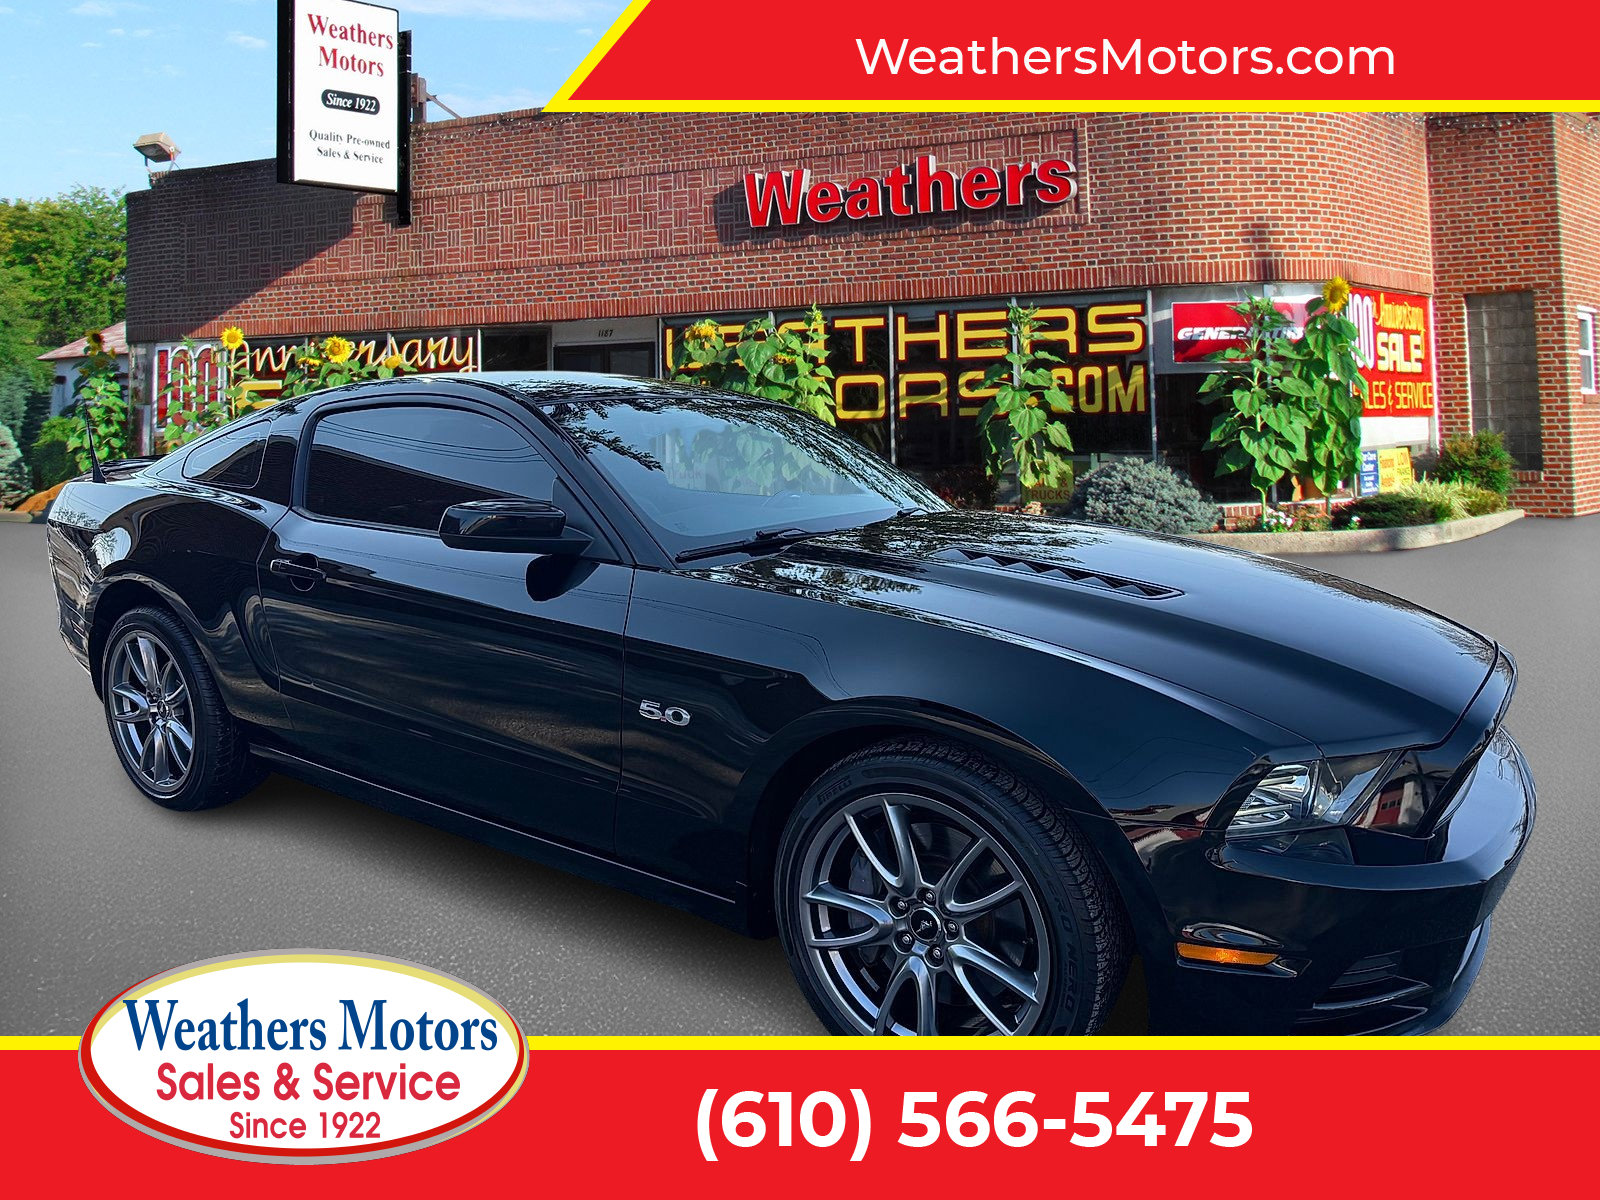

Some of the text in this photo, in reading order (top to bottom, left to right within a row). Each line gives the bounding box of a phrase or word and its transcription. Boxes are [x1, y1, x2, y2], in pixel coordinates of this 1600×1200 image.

[307, 13, 393, 50] Weathers
[319, 46, 384, 77] Motors
[326, 93, 376, 112] Since 1922
[309, 129, 390, 149] Quality Pre-owned
[317, 146, 383, 164] Sales & Service
[743, 155, 1078, 228] Weathers
[598, 329, 614, 338] 1187
[1377, 332, 1423, 373] SALE
[1352, 382, 1386, 409] LES
[1395, 382, 1434, 409] SERVICE
[639, 699, 691, 727] 5.0
